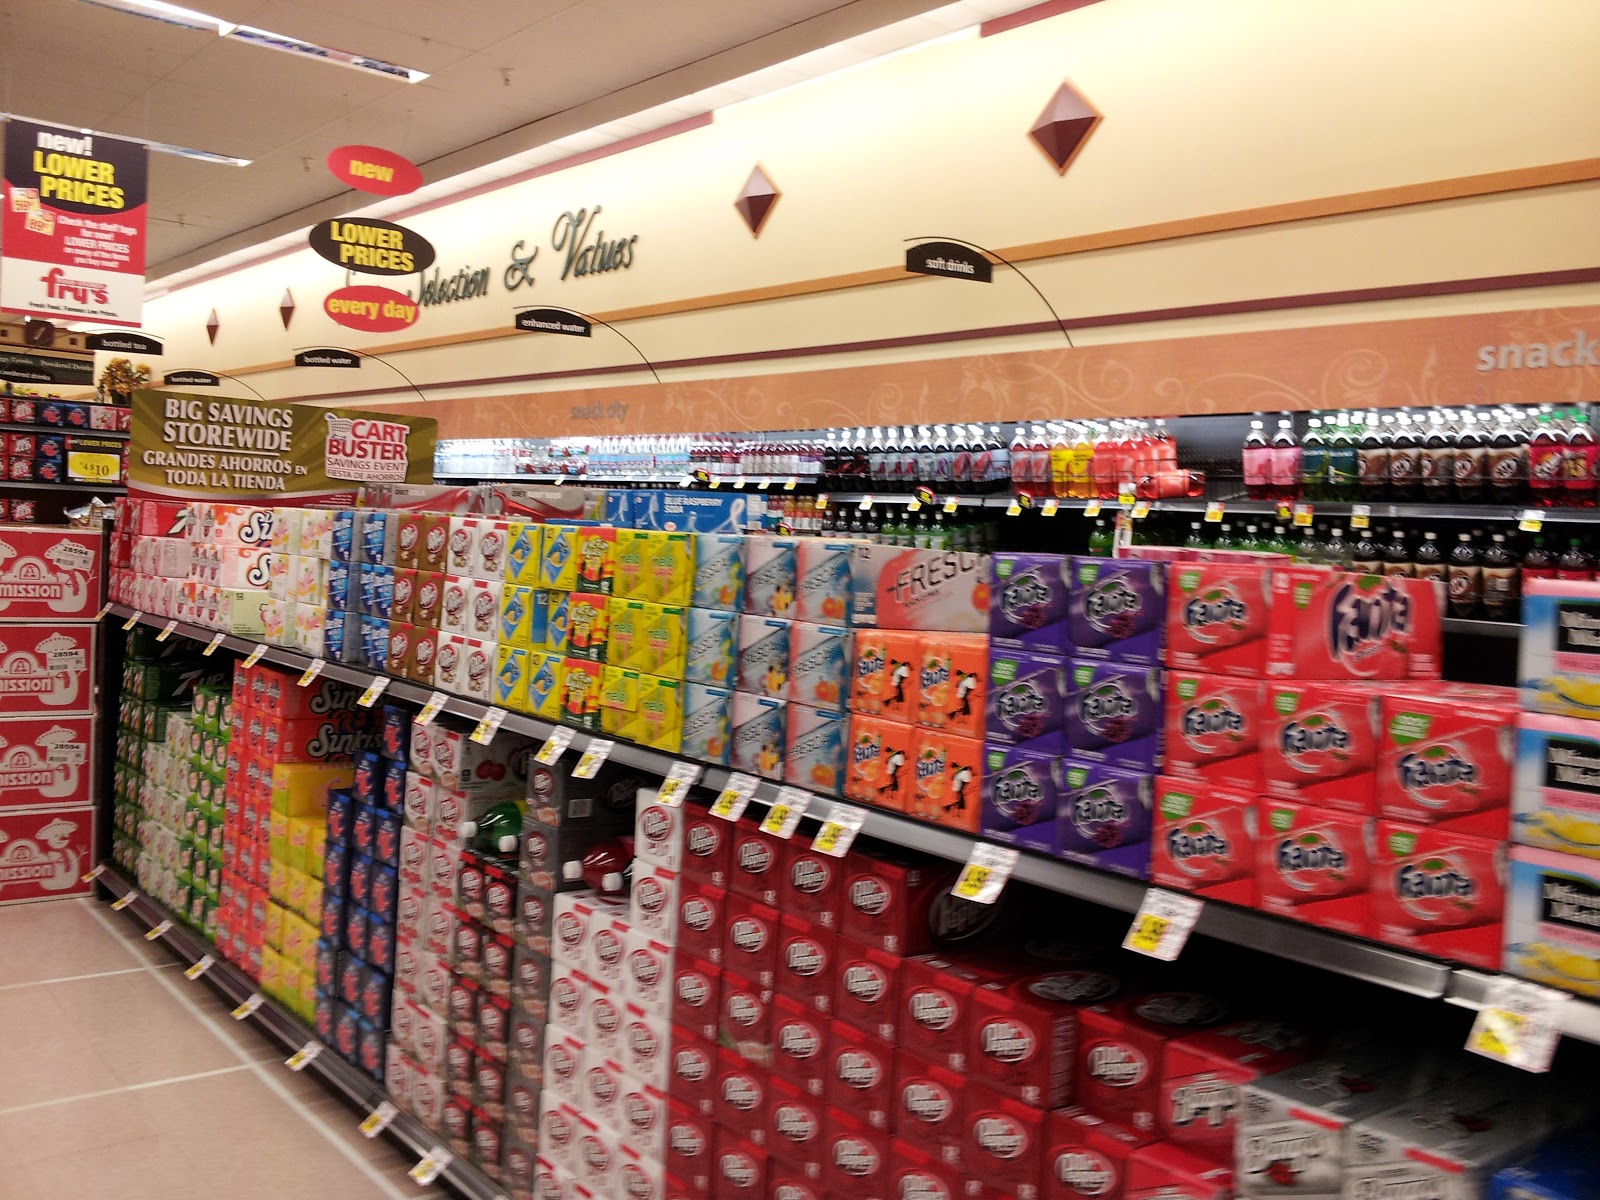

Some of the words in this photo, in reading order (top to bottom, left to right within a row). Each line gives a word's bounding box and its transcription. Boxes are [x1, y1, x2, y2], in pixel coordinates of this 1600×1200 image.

[37, 131, 93, 157] new!
[33, 150, 115, 185] LOWER
[350, 159, 394, 183] new
[40, 175, 125, 210] PRICES
[63, 236, 97, 248] LOWER
[98, 241, 130, 253] PRICES
[330, 221, 404, 251] LOWER
[339, 243, 415, 273] PRICES
[417, 265, 491, 307] election
[504, 239, 539, 291] &
[551, 204, 640, 281] Values
[925, 257, 946, 270] soft
[947, 259, 975, 275] drinks
[40, 267, 110, 305] fry's
[328, 296, 380, 320] every
[384, 300, 417, 324] day
[521, 318, 561, 332] enhanced
[562, 322, 586, 335] water
[102, 338, 133, 350] bottled
[134, 342, 147, 351] tea
[1476, 328, 1600, 373] snack
[304, 356, 331, 365] bottled
[0, 370, 31, 379] owdered
[171, 375, 193, 384] bottled
[165, 398, 202, 421] BIG
[208, 402, 293, 428] SAVINGS
[163, 420, 293, 452] STOREWIDE
[351, 421, 407, 443] CART
[80, 439, 100, 448] LOWER
[101, 440, 122, 449] PRICES
[328, 438, 405, 461] BUSTER
[142, 450, 216, 470] GRANDES
[219, 455, 293, 475] AHORROS
[294, 464, 308, 476] EN
[327, 457, 371, 470] SAVINGS
[373, 461, 406, 472] EVENT
[165, 469, 207, 487] TODA
[210, 472, 228, 488] LA
[231, 473, 286, 491] TIENDA
[327, 468, 352, 478] FIESTA
[354, 471, 364, 479] DE
[366, 472, 405, 482] AHORROS
[395, 488, 409, 497] DIET
[512, 489, 527, 498] DIET
[664, 496, 683, 506] BLUE
[664, 505, 684, 514] SODA
[306, 723, 381, 758] Sunkis
